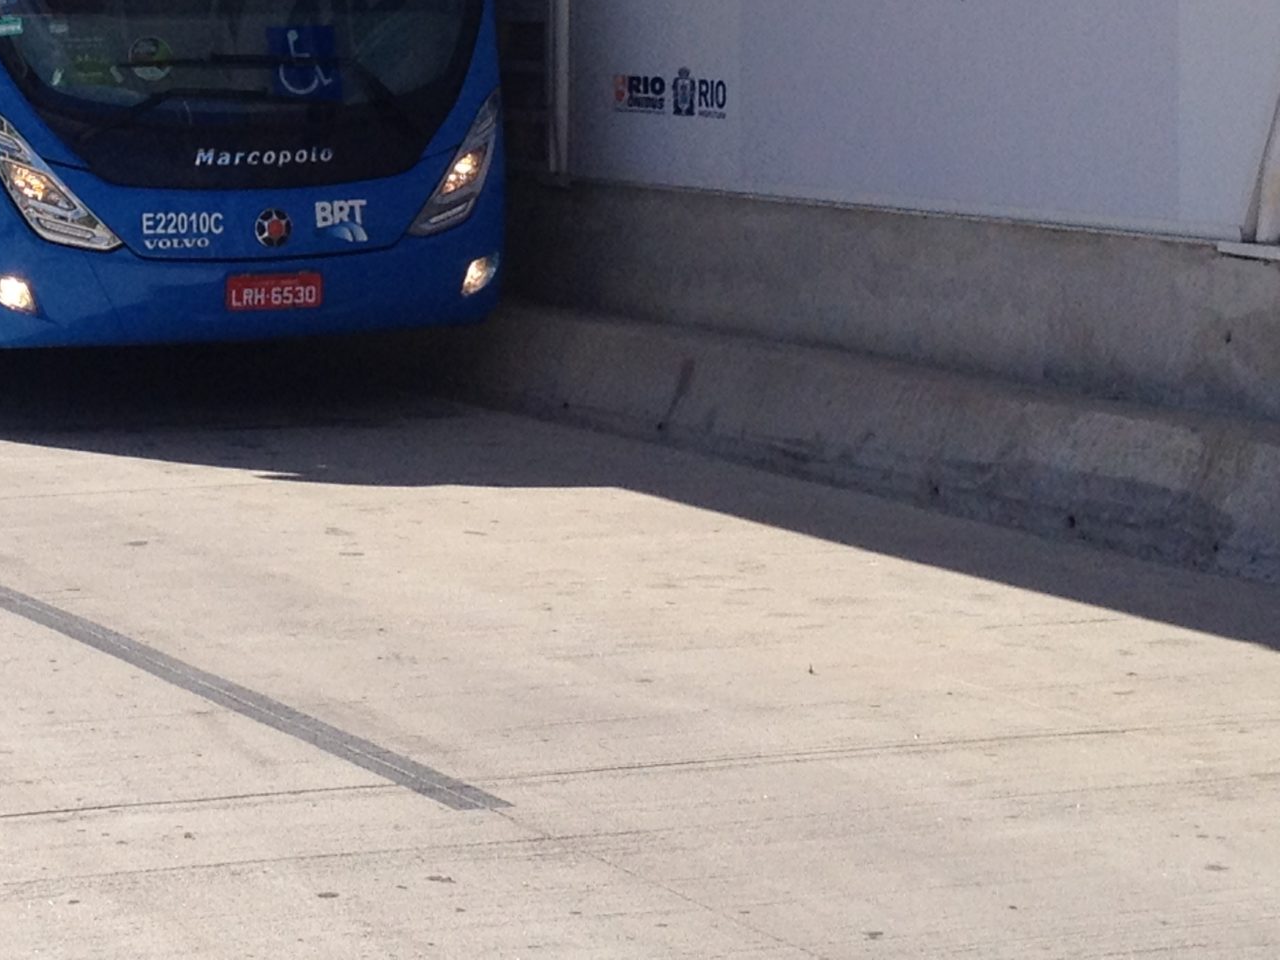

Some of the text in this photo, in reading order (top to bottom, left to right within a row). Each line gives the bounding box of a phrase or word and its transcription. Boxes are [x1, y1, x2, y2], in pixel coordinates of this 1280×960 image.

[627, 76, 666, 96] RIO
[698, 79, 727, 109] RIO
[195, 147, 334, 167] Marcopolo
[141, 212, 224, 235] E22010C
[314, 199, 368, 229] BRT
[143, 238, 210, 250] VOLVO
